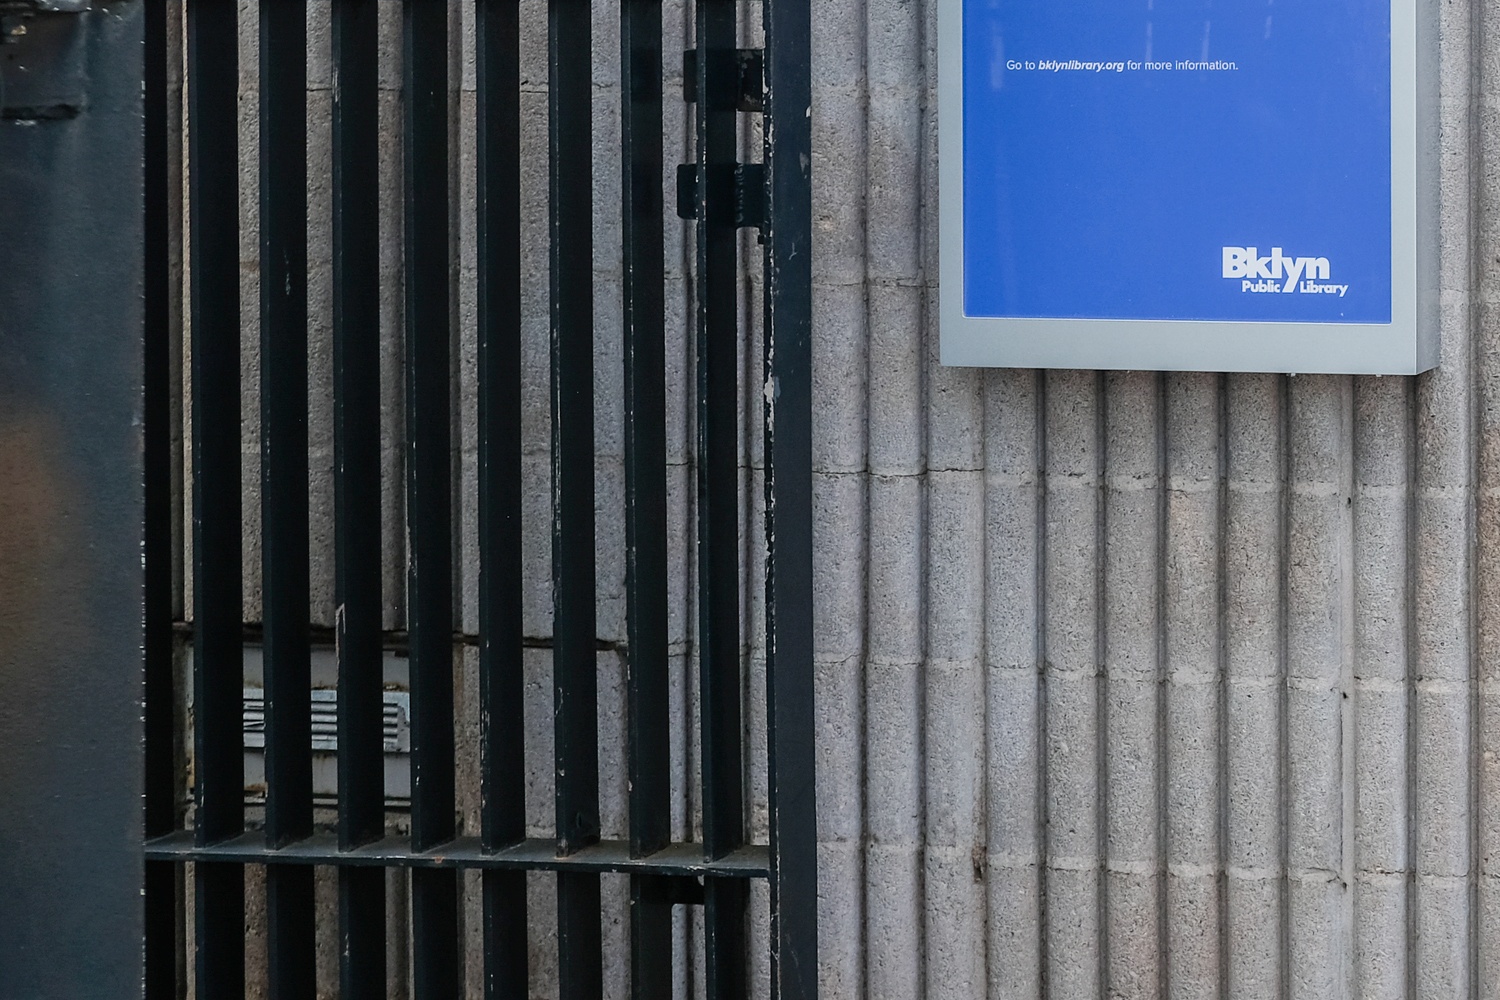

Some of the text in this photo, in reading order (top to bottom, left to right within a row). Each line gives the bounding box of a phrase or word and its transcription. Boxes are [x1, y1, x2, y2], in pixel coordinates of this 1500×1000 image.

[1006, 60, 1239, 72] Go to bklynlibrary.org for more information.
[1222, 246, 1330, 292] Bklyn
[1242, 280, 1348, 297] Public Library
